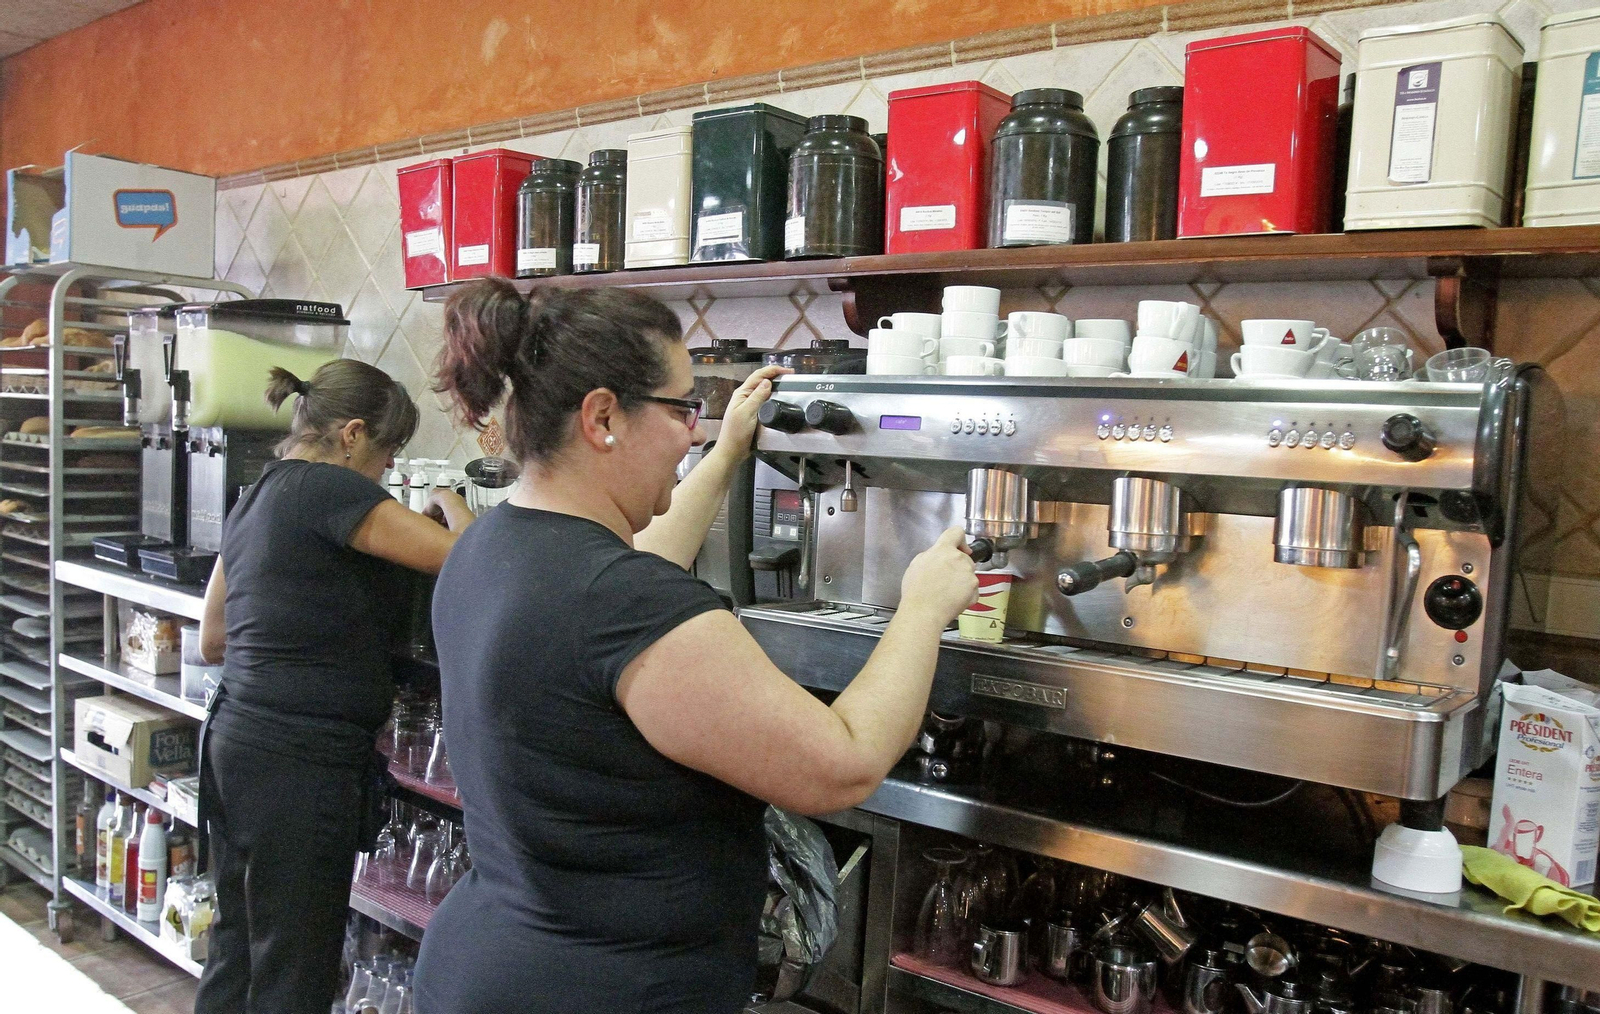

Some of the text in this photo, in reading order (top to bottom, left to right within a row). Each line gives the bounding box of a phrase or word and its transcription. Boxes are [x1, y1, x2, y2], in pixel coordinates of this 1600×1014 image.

[296, 304, 336, 314] natfood
[815, 383, 835, 391] G-10
[974, 677, 1063, 706] EXPOBAR
[1510, 719, 1574, 743] PRÉSIDENT
[1507, 763, 1543, 782] Entera
